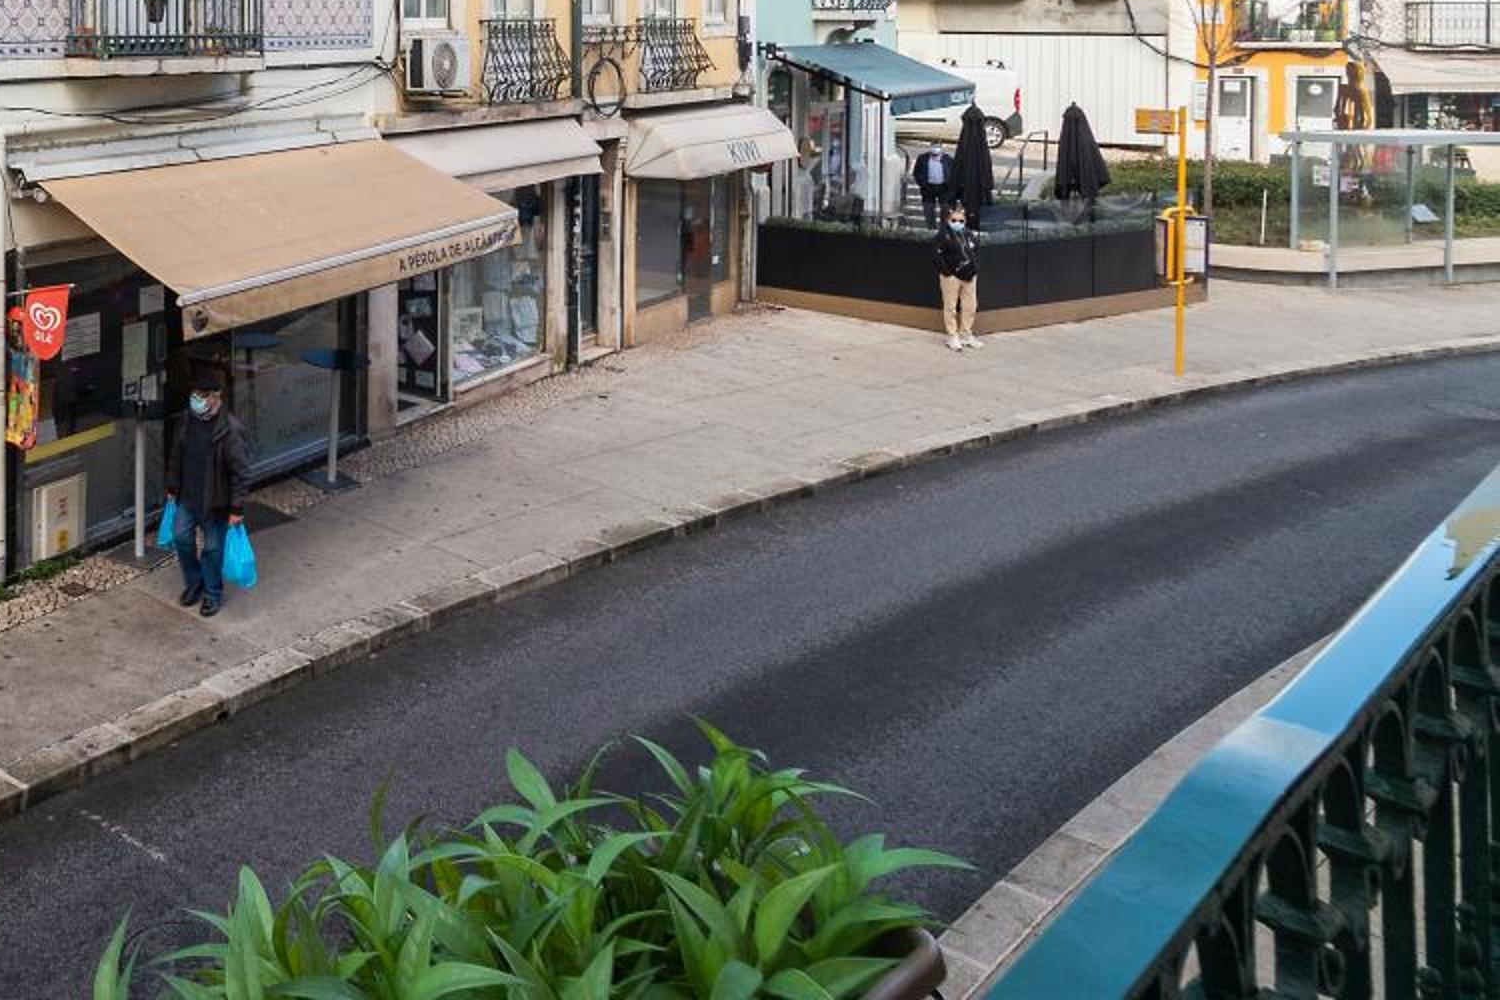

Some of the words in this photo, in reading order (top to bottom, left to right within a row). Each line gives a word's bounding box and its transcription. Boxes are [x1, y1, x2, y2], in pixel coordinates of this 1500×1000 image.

[726, 139, 761, 163] KIWI
[399, 258, 407, 272] A
[407, 247, 447, 268] PÉROLA
[449, 243, 462, 258] DE
